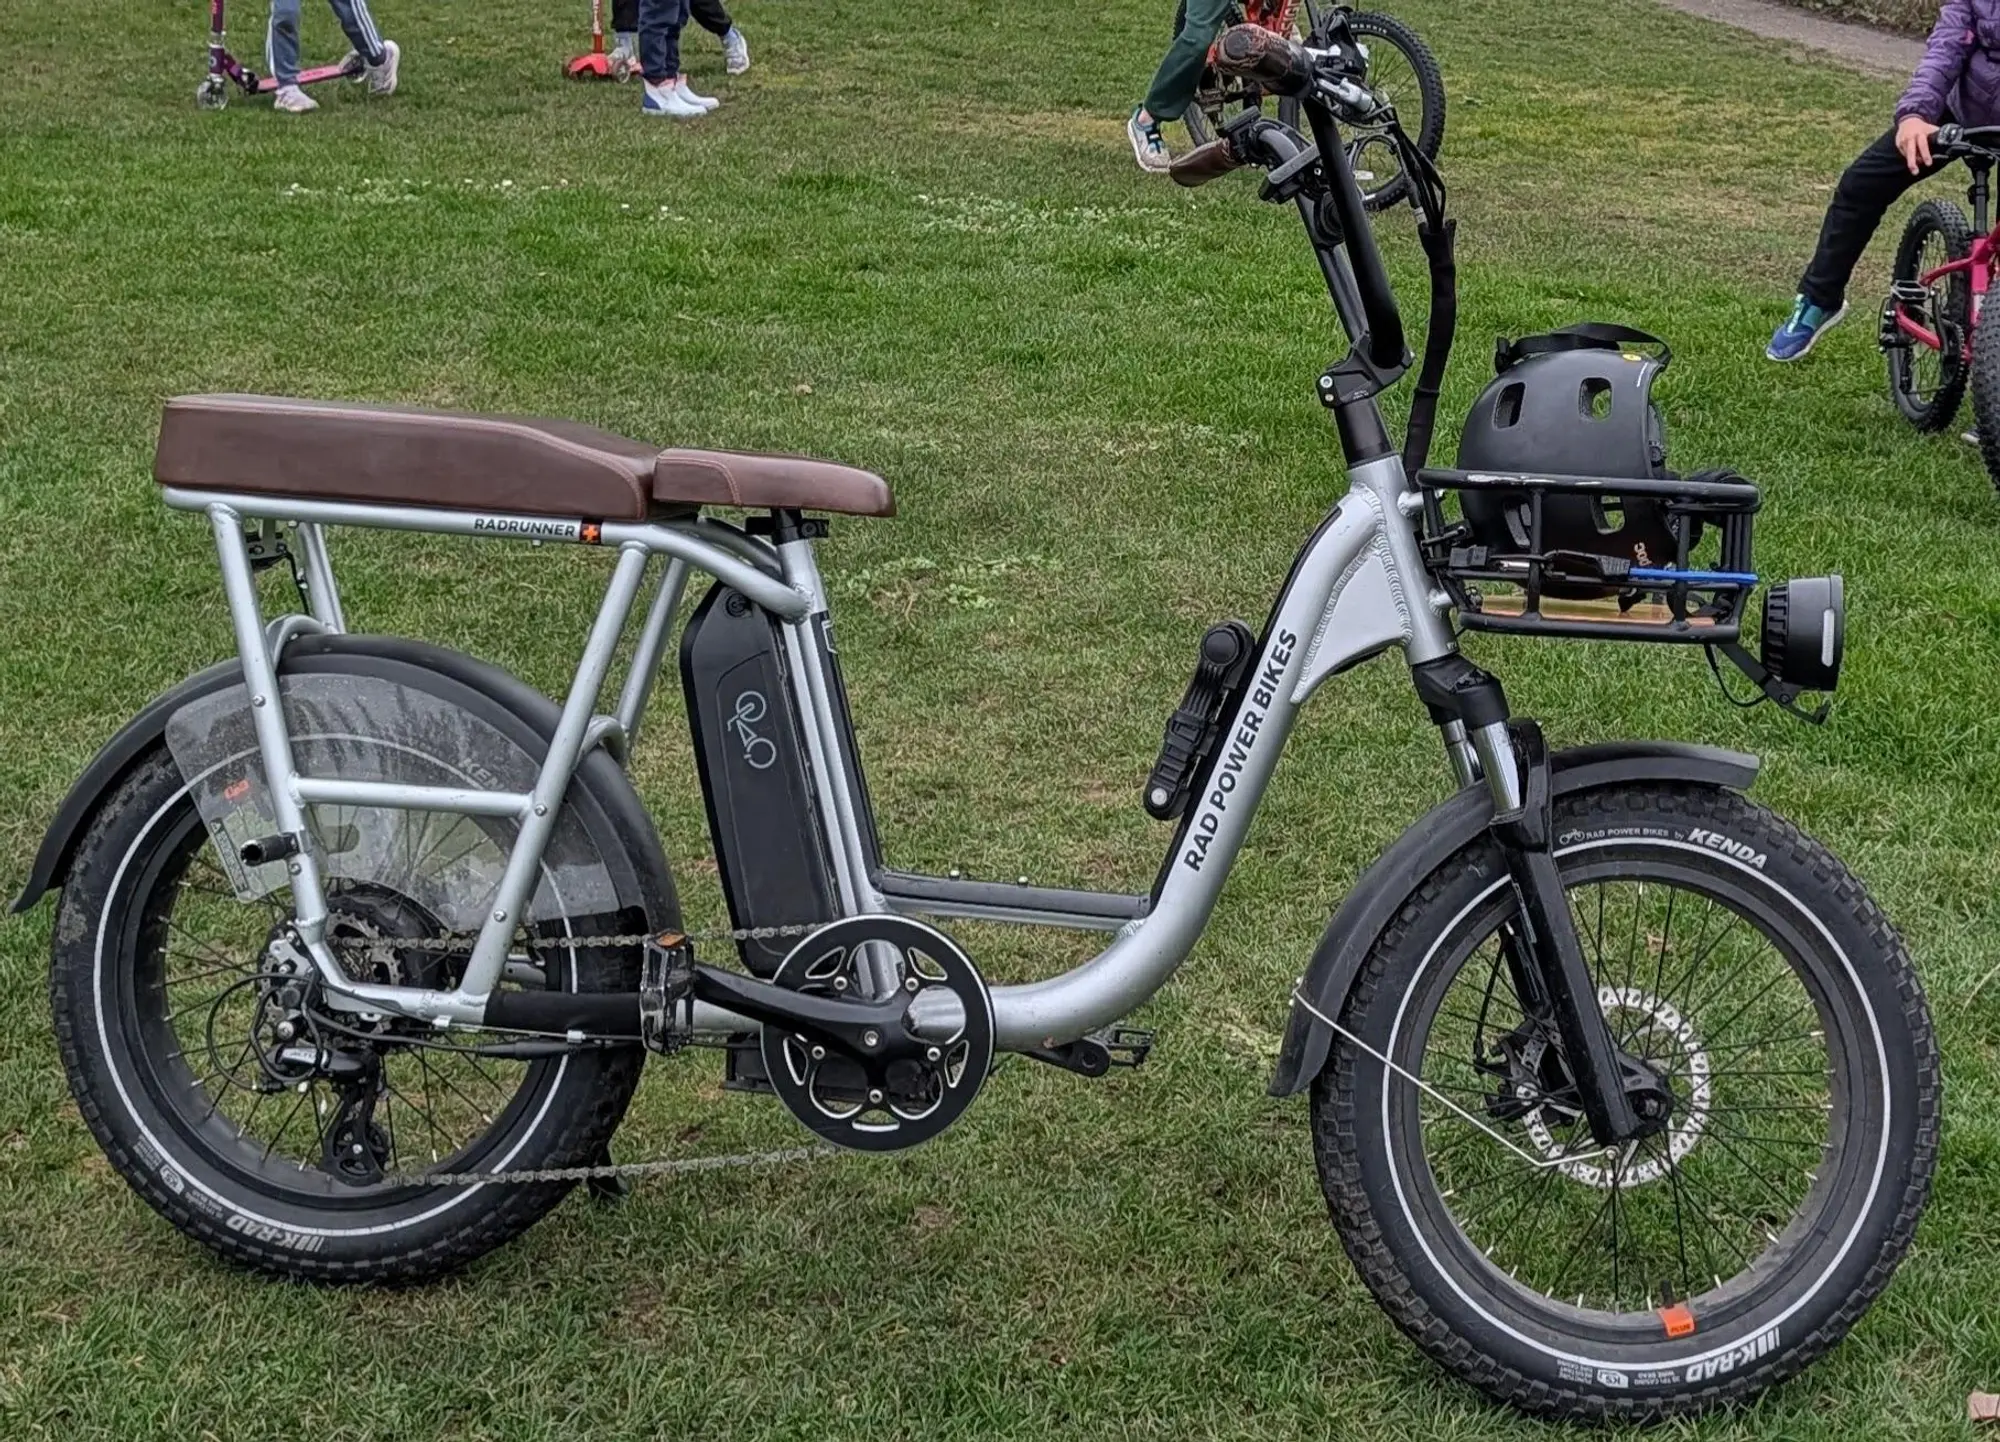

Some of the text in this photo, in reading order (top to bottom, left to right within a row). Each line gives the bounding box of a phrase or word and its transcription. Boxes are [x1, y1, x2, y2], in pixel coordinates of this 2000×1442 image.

[474, 518, 575, 537] RADRUNNER
[1184, 628, 1297, 872] RAD POWER BIKES
[1586, 827, 1768, 870] RAD POWER BIKES by KENDA
[226, 1214, 302, 1250] K-RAD
[1605, 1375, 1621, 1385] KS
[1685, 1346, 1757, 1384] K-RAD
